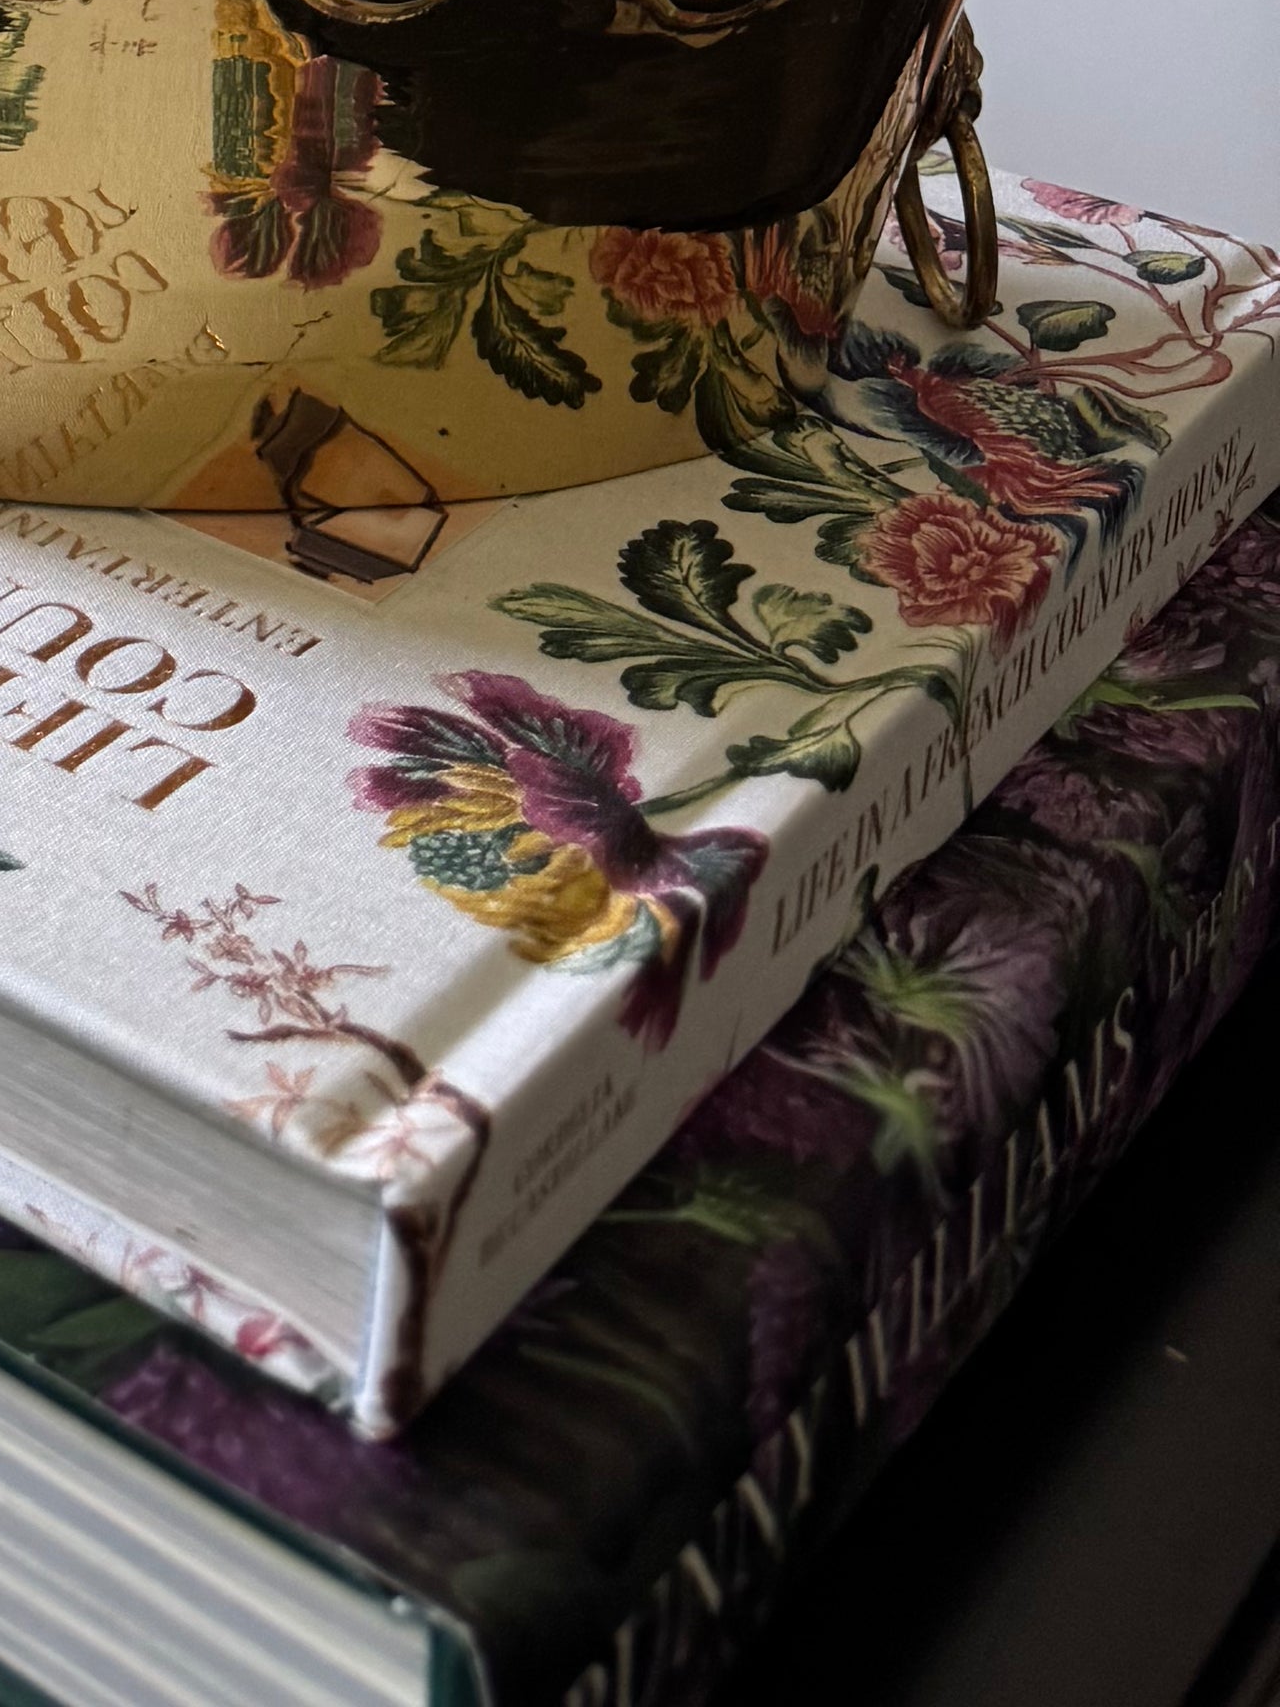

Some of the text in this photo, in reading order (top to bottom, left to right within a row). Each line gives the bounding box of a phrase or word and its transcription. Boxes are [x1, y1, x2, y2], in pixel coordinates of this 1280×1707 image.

[771, 831, 849, 956] LIFE
[854, 788, 889, 871] IN
[1040, 517, 1158, 676] COUNTRY
